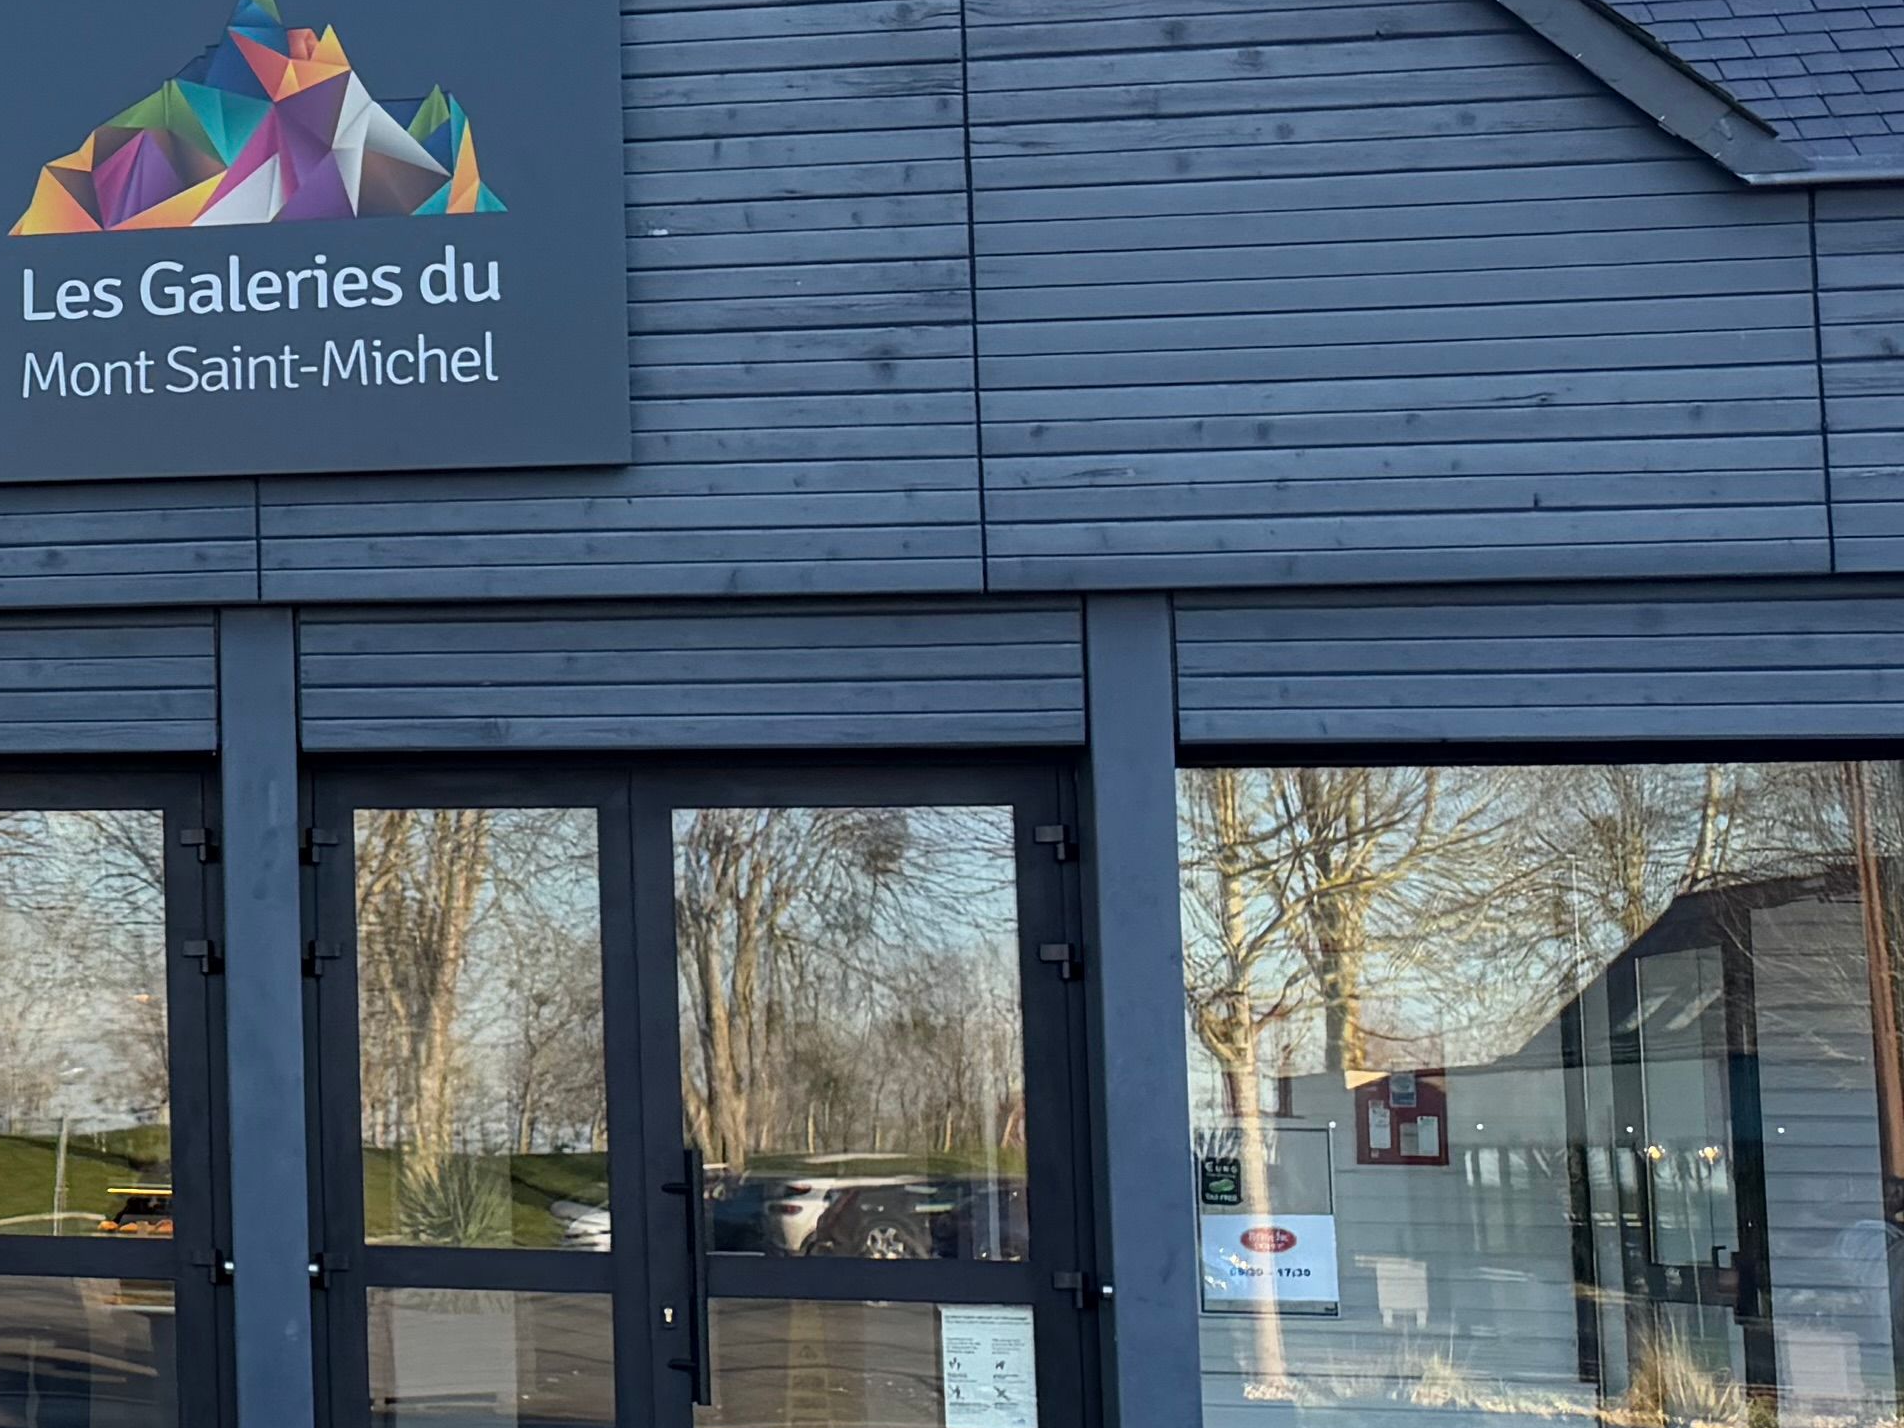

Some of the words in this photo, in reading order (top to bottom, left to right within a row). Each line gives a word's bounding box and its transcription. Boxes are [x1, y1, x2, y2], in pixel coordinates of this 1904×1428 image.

[22, 266, 124, 322] Les
[139, 253, 402, 315] Galeries
[419, 244, 501, 304] du
[22, 348, 155, 399] Mont
[166, 331, 499, 394] Saint-Michel
